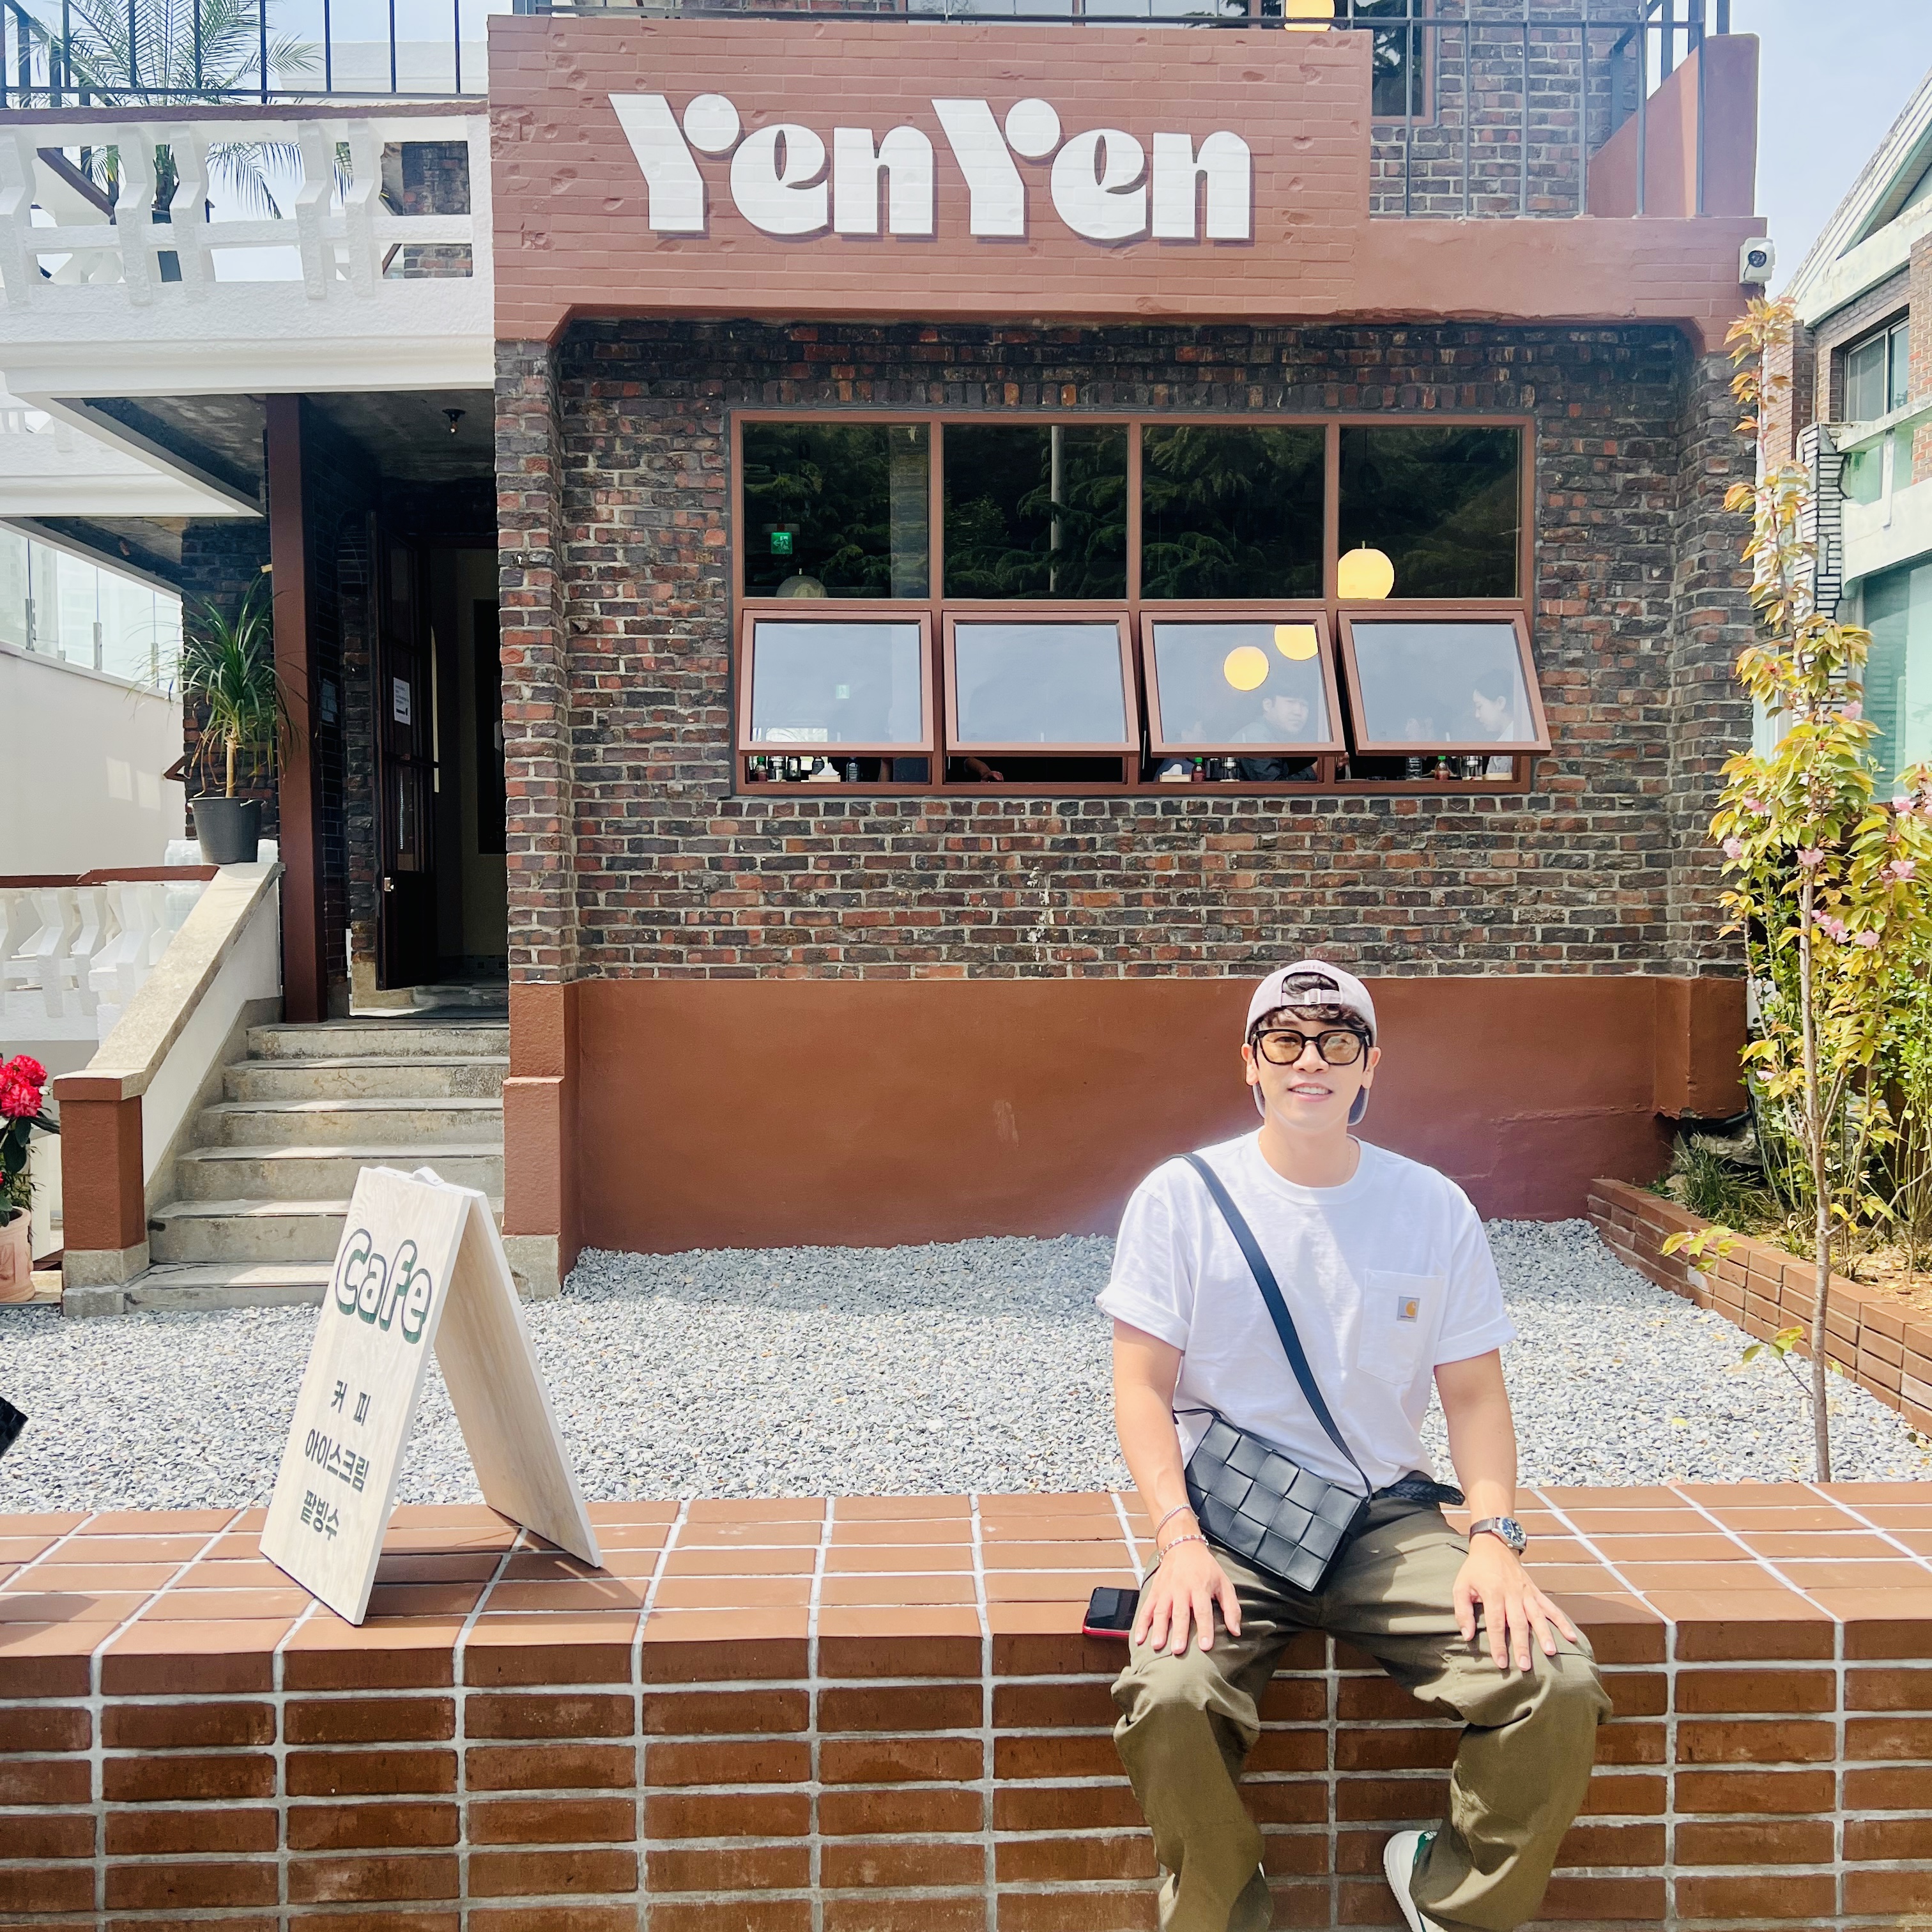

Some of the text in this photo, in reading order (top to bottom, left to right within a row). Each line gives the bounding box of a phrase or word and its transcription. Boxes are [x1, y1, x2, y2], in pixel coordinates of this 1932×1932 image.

[608, 93, 1252, 240] YenYen
[335, 1228, 432, 1344] Cafe
[305, 1428, 370, 1493] 아이스크림
[300, 1489, 339, 1541] 팥빙수
